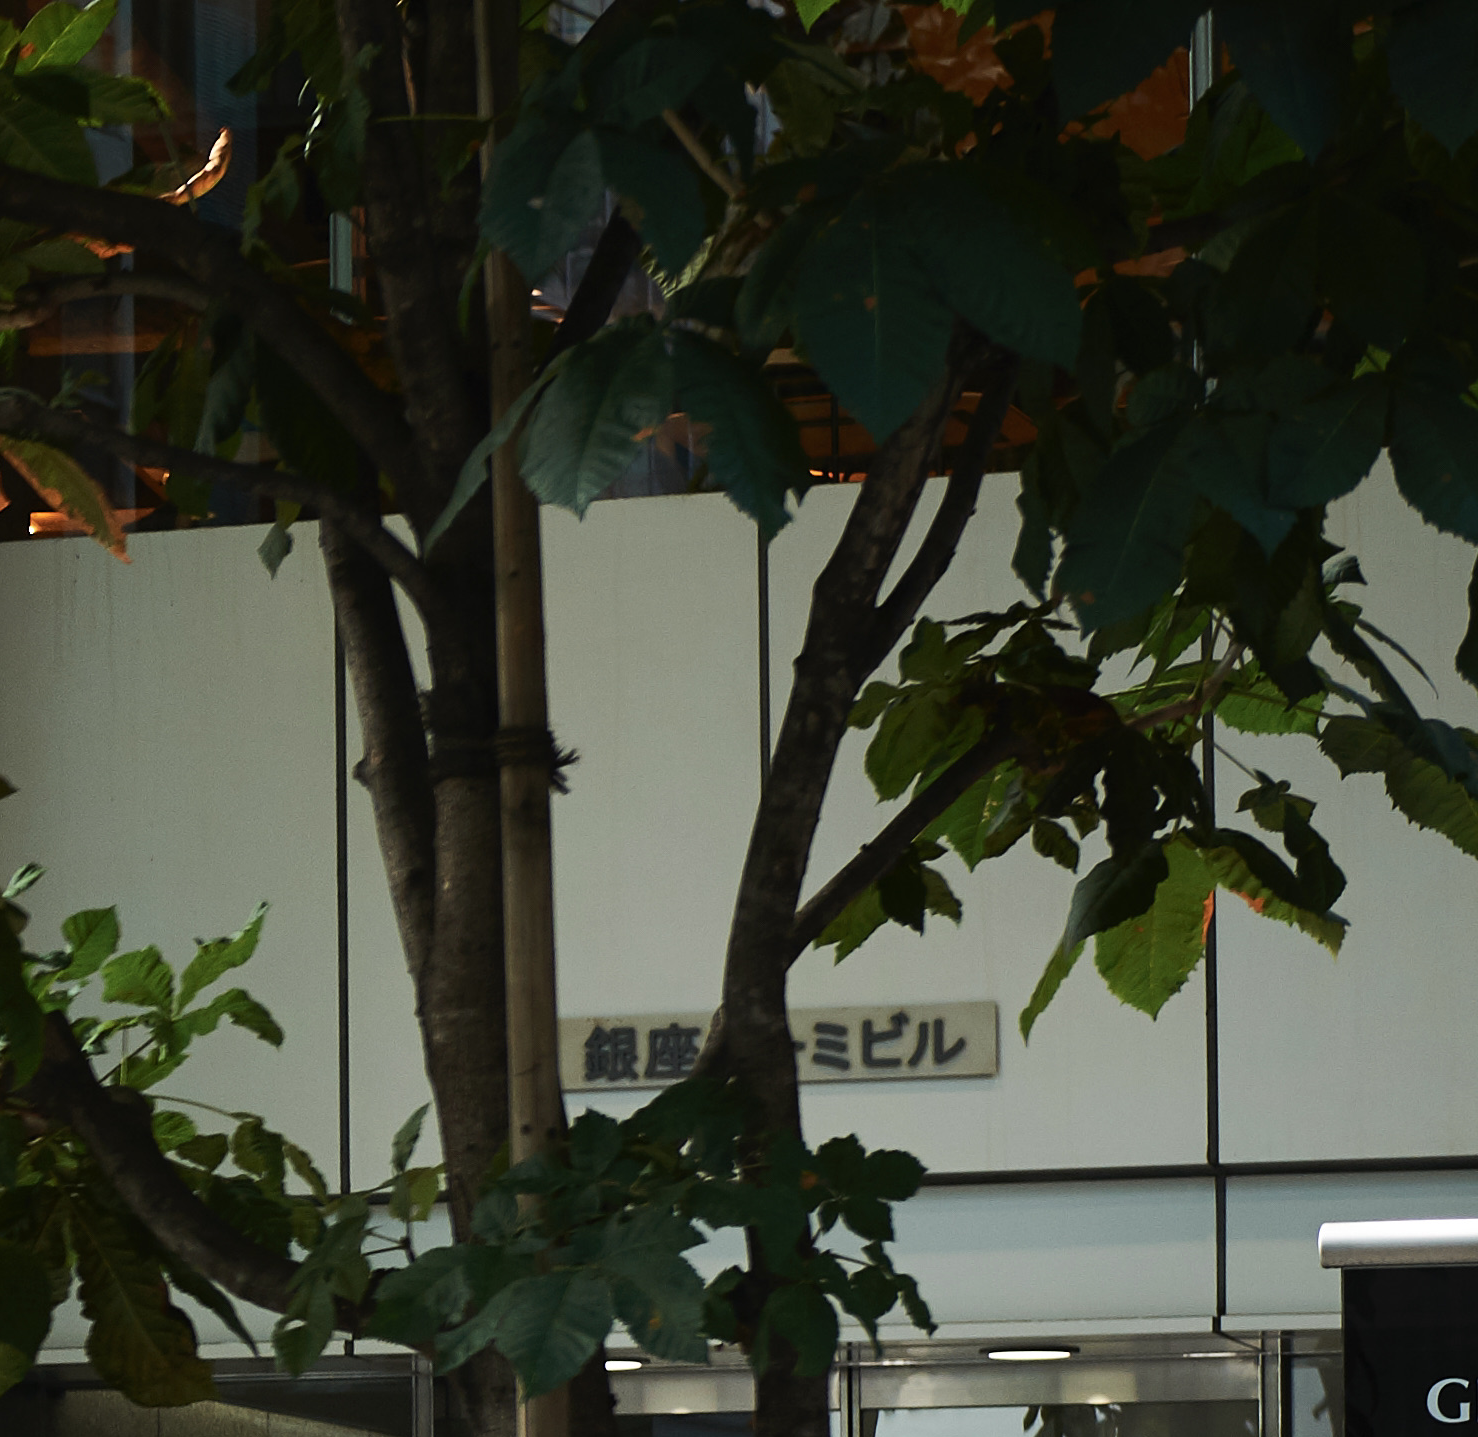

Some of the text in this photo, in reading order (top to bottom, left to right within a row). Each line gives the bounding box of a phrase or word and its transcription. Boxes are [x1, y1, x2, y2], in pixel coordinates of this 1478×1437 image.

[583, 1009, 967, 1084] 銀座ミビル
[1426, 1377, 1472, 1424] G
